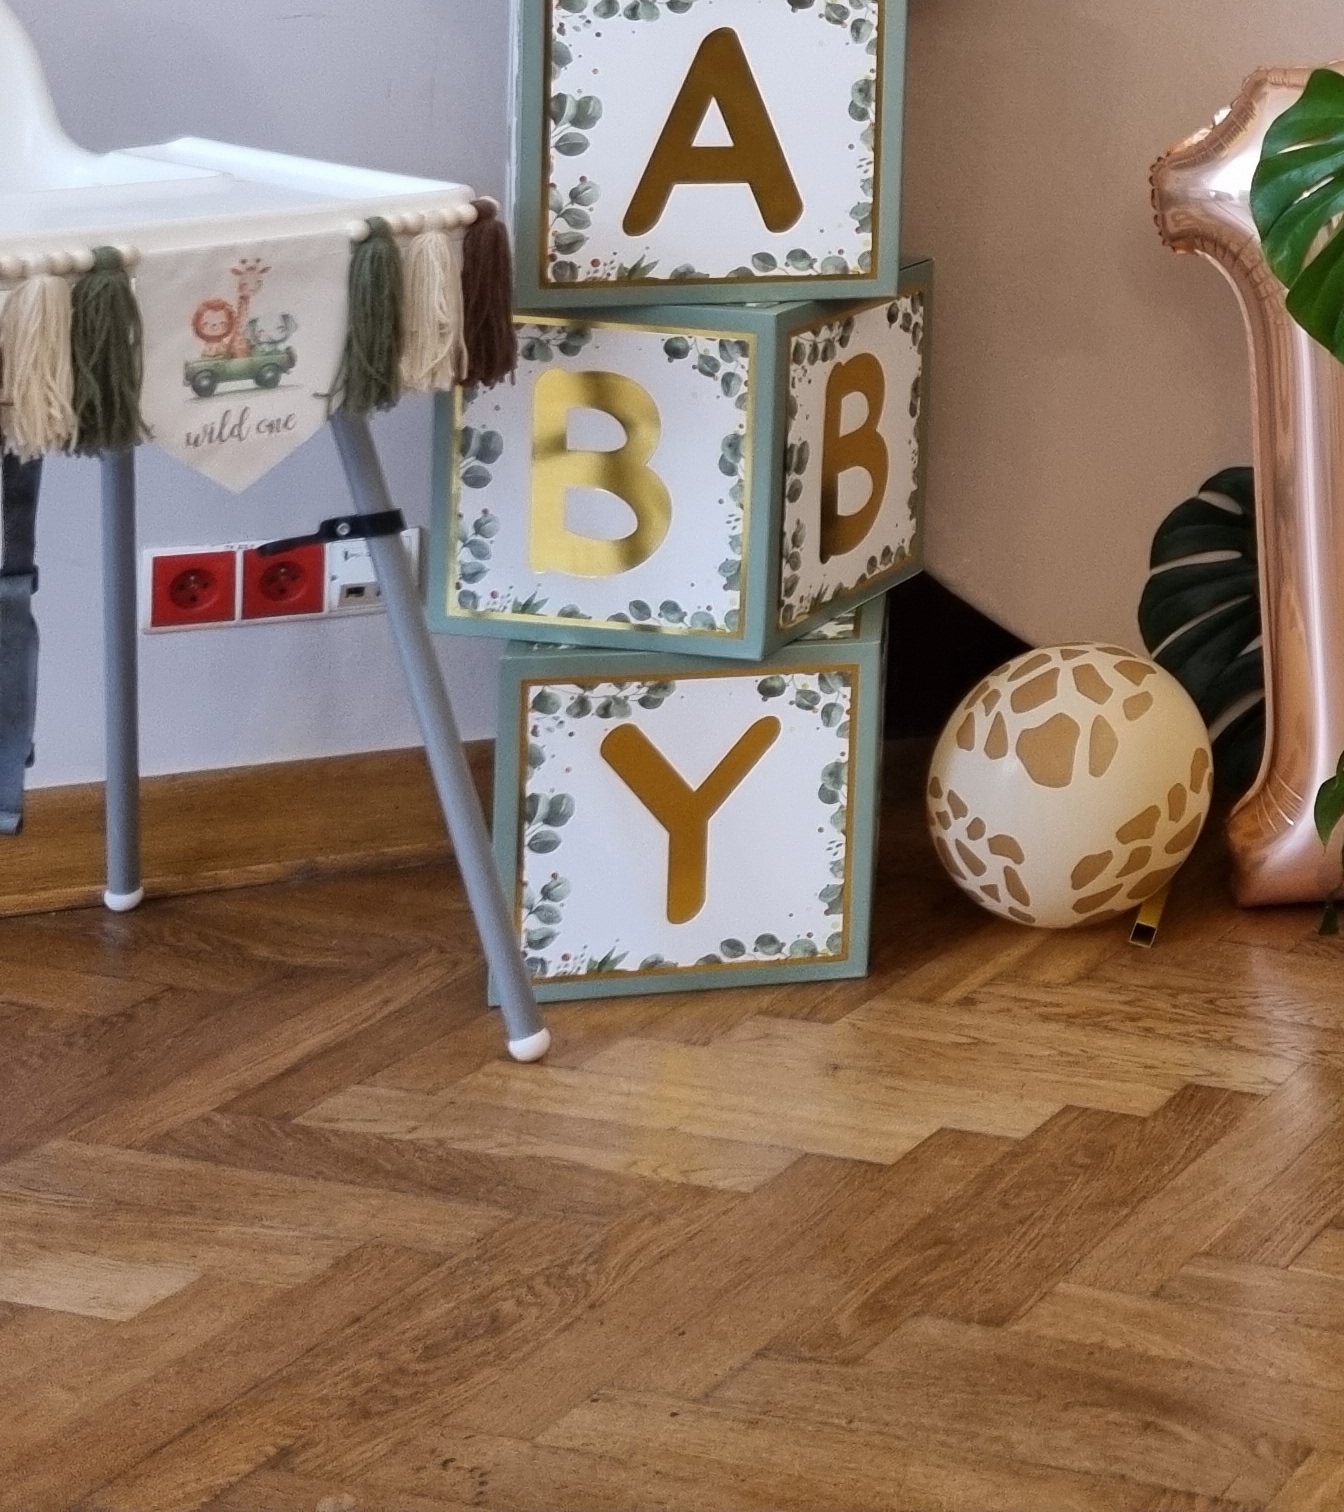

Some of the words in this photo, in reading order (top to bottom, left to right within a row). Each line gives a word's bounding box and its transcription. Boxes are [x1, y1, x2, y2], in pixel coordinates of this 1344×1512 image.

[622, 25, 804, 237] A
[185, 406, 251, 447] wild
[256, 412, 298, 435] one
[529, 367, 673, 578] B
[820, 352, 889, 565] B
[600, 715, 782, 925] Y
